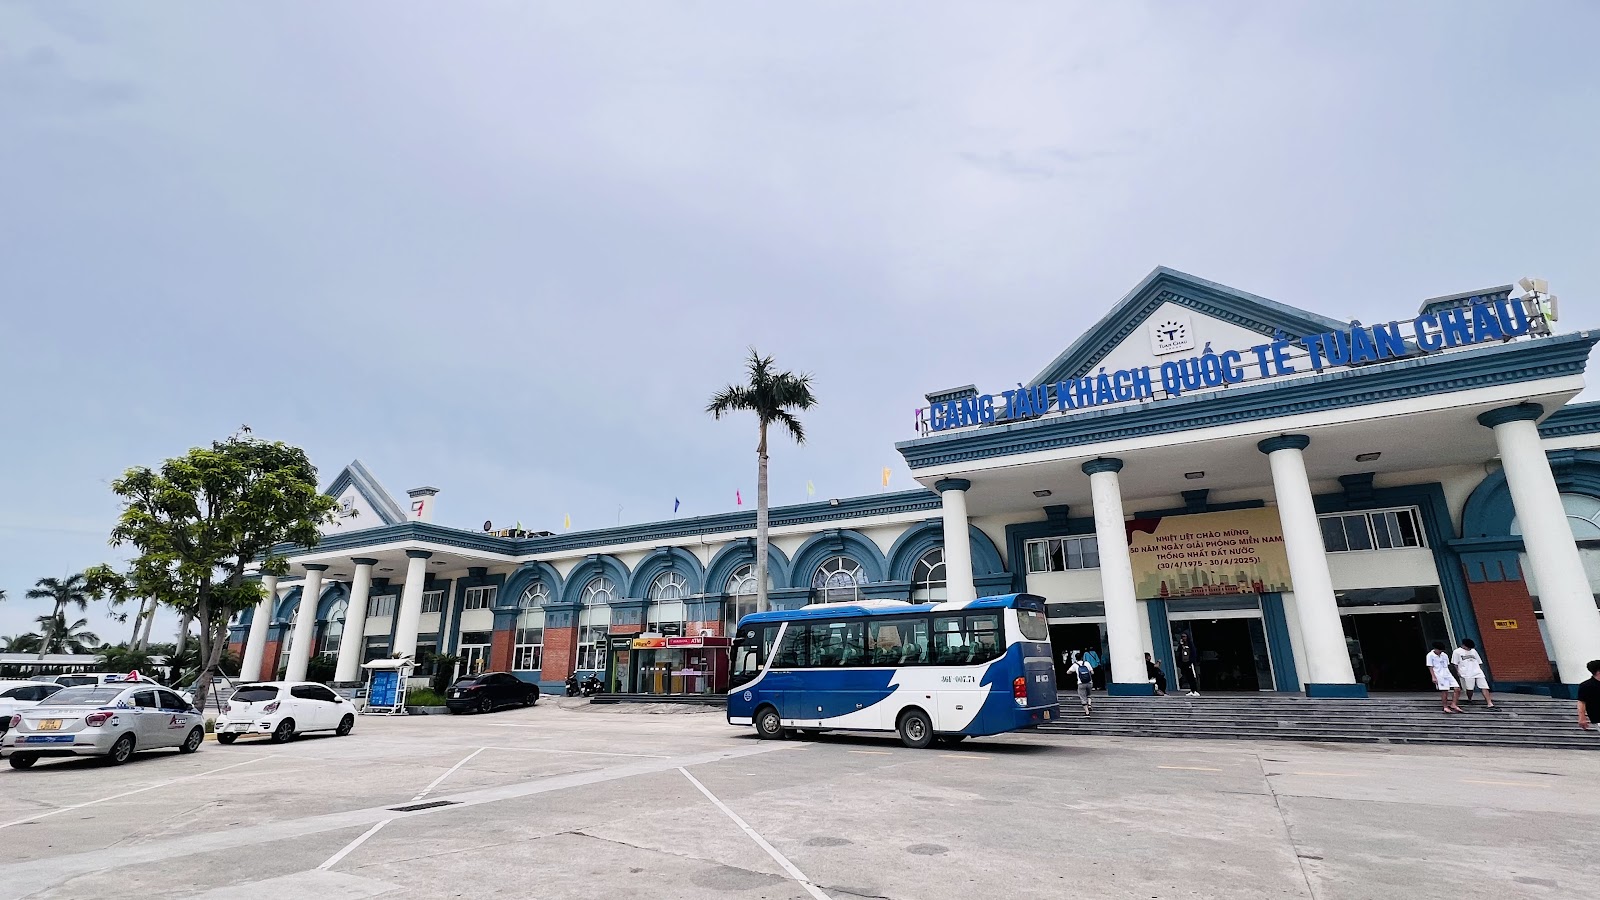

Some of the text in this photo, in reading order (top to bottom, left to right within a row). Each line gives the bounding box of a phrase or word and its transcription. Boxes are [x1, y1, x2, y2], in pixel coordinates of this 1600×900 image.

[1001, 383, 1050, 421] TÀU
[1056, 367, 1152, 411] KHÁCH
[1160, 341, 1244, 397] QUỐC
[1251, 327, 1295, 378] TẾ
[1413, 296, 1530, 352] CHÂU
[1156, 528, 1250, 543] NHIỆT LIỆT CHÀO MỪNG
[1141, 544, 1159, 552] NĂM
[1161, 542, 1184, 551] NGÀY
[1186, 540, 1204, 549] GIẢI
[1206, 538, 1237, 547] PHÓNG
[1239, 535, 1260, 545] MIỀN
[1156, 546, 1255, 560] THỐNG NHẤT ĐẤT NƯỚC
[1157, 560, 1203, 570] (30/4/1975
[1209, 556, 1261, 565] 30/4/2025)!
